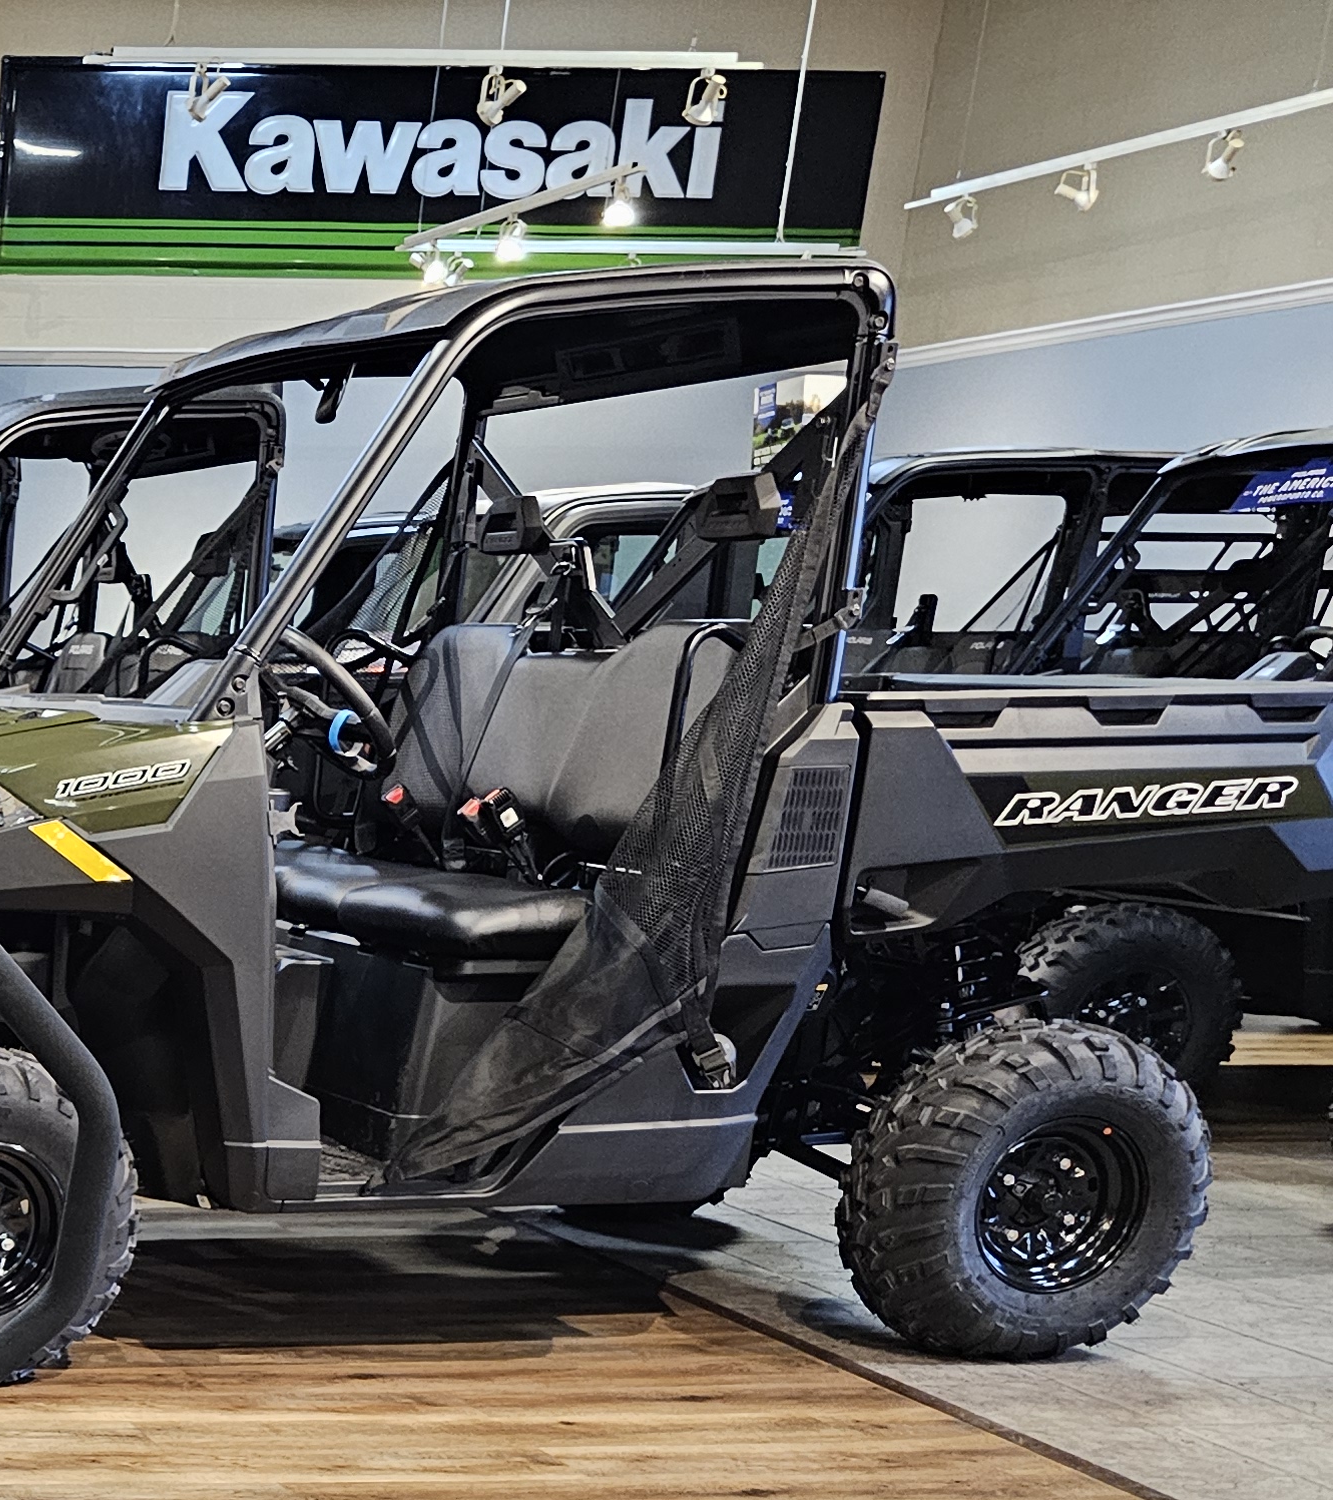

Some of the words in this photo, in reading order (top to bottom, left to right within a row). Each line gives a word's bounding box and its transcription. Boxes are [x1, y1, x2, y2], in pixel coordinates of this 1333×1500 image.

[157, 89, 728, 202] Kawasaki
[1252, 481, 1280, 498] THE
[1277, 475, 1333, 493] AMERIC
[54, 757, 192, 799] 1000
[993, 775, 1299, 827] RANGER
